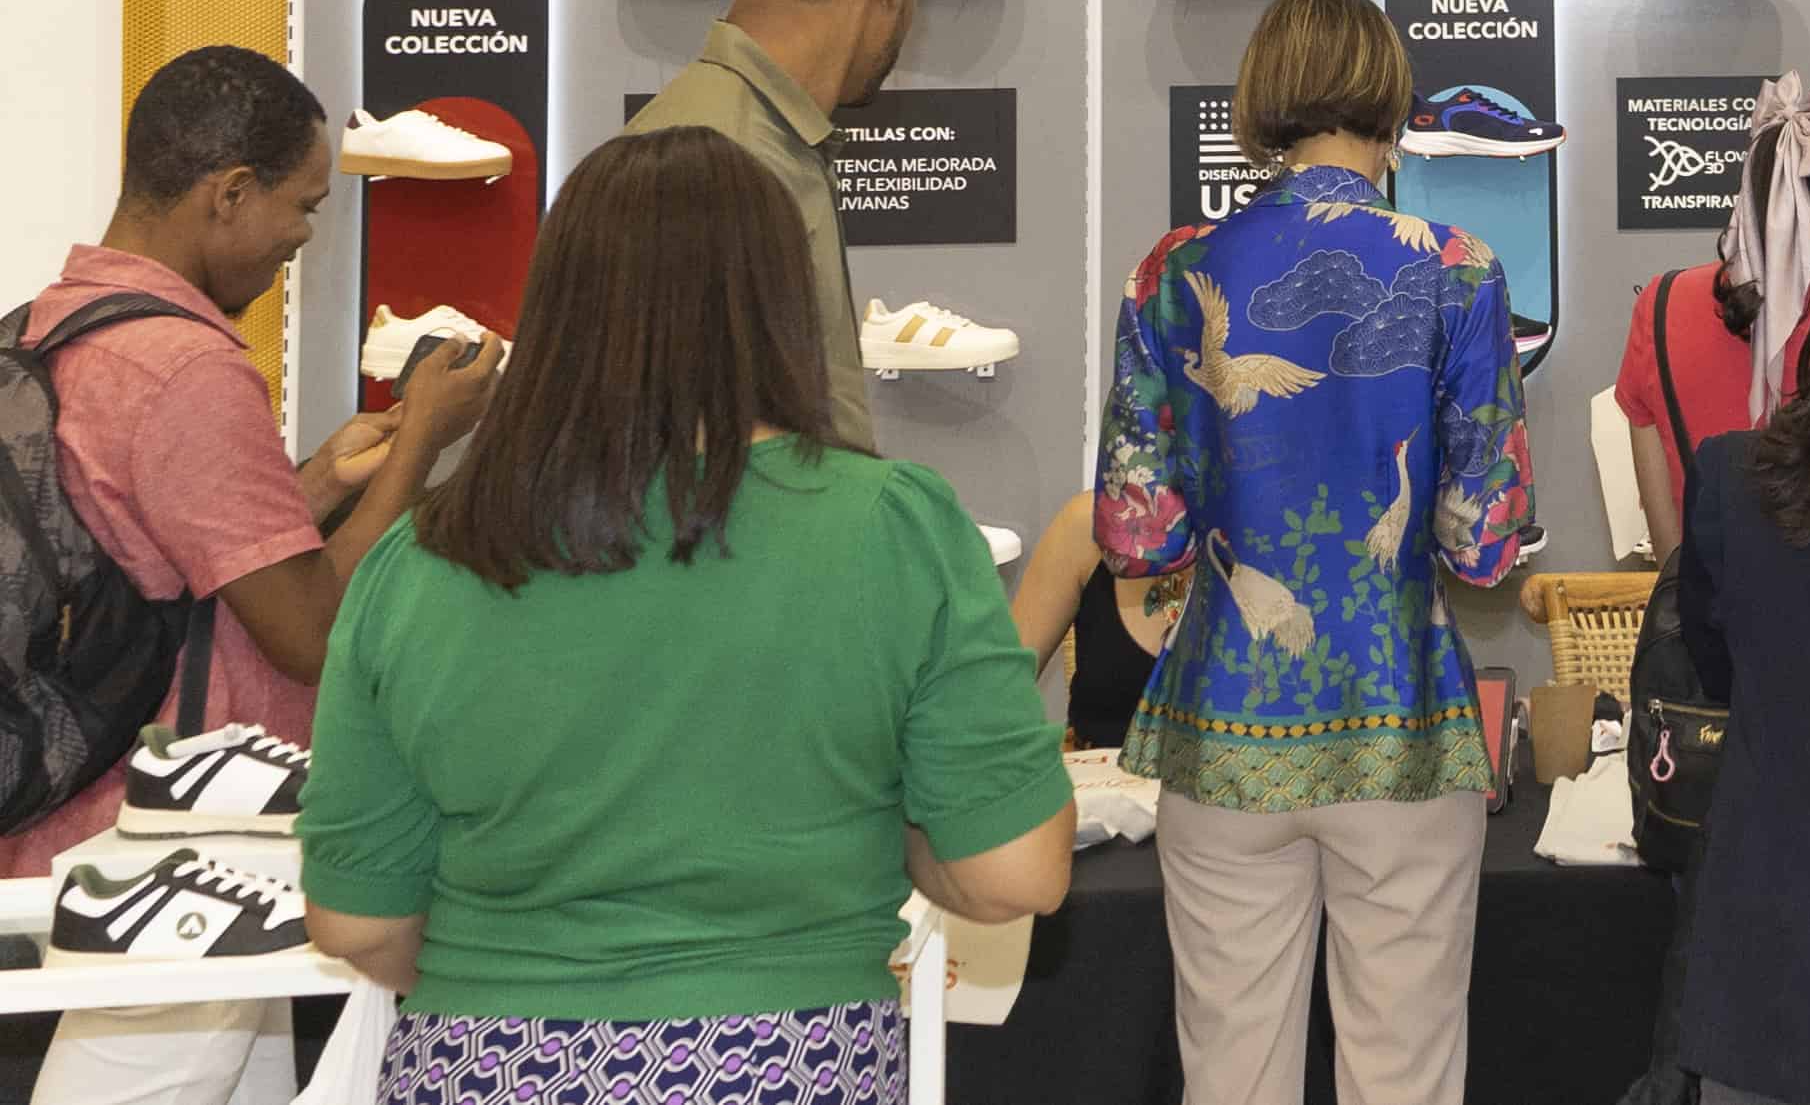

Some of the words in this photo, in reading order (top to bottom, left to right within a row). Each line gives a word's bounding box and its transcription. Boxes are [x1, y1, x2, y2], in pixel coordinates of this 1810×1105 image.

[411, 8, 496, 28] NUEVA
[1408, 18, 1538, 39] COLECCIÓN
[385, 31, 528, 55] COLECCIÓN
[1628, 98, 1728, 112] MATERIALES
[1732, 98, 1756, 111] CO
[1647, 115, 1753, 131] TECNOLOGÍA
[846, 127, 905, 142] TILLAS
[910, 127, 955, 141] CON:
[834, 159, 897, 173] TENCIA
[902, 157, 996, 172] MEJORADA
[1704, 163, 1724, 174] 3D
[1199, 167, 1270, 180] DISEÑADO
[856, 177, 967, 192] FLEXIBILIDAD
